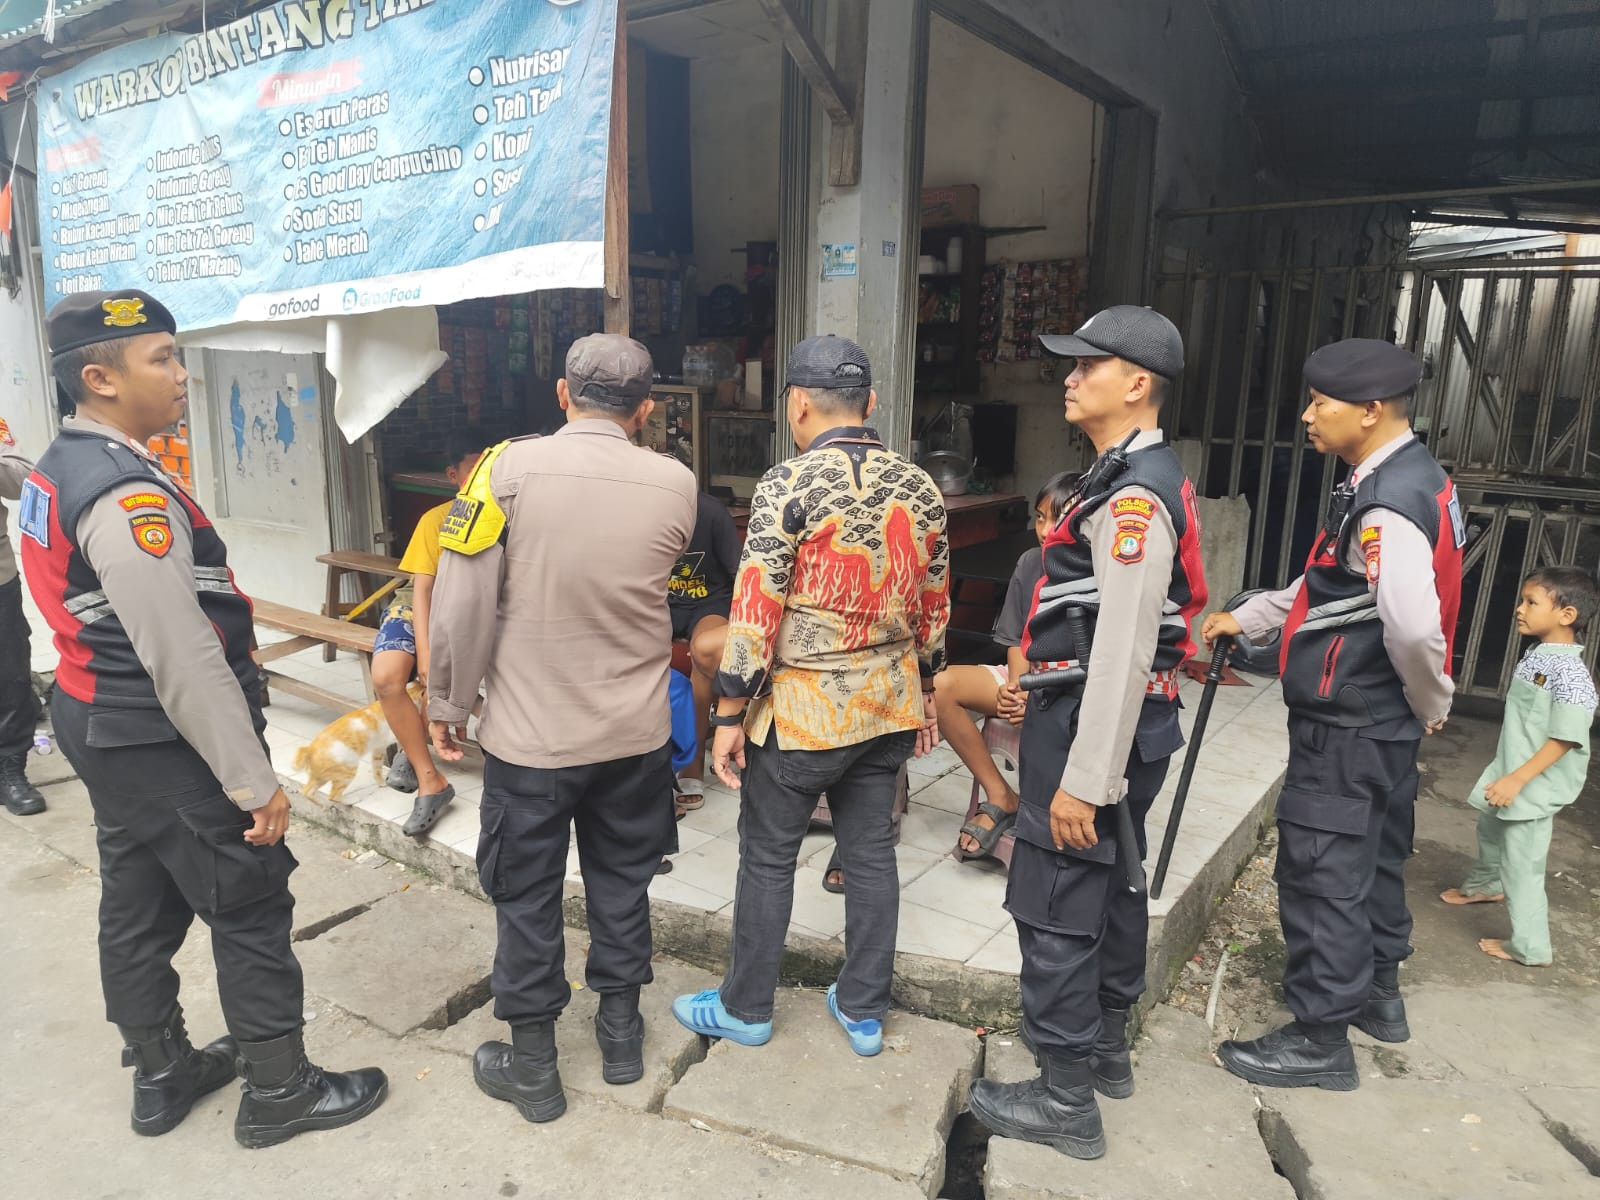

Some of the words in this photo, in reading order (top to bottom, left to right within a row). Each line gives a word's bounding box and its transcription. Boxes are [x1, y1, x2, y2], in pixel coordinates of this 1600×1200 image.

[185, 0, 355, 85] BINTANG
[313, 100, 350, 131] eruk
[350, 91, 389, 123] Peras
[493, 91, 528, 125] Teh
[156, 143, 201, 173] Indomie
[310, 136, 336, 165] Teh
[337, 126, 378, 160] Manis
[77, 168, 108, 191] Goreng
[347, 161, 373, 190] Day
[373, 143, 463, 184] Cappucino
[156, 172, 198, 201] Indomie
[156, 204, 175, 229] Mie
[328, 198, 363, 226] Susu
[85, 219, 117, 242] Kacang
[156, 232, 175, 256] Mie
[213, 222, 254, 248] Goreng
[325, 227, 369, 257] Merah
[182, 256, 199, 281] 1/2
[198, 254, 242, 278] Matang
[267, 293, 320, 320] gofood
[1116, 498, 1152, 510] POLSEK
